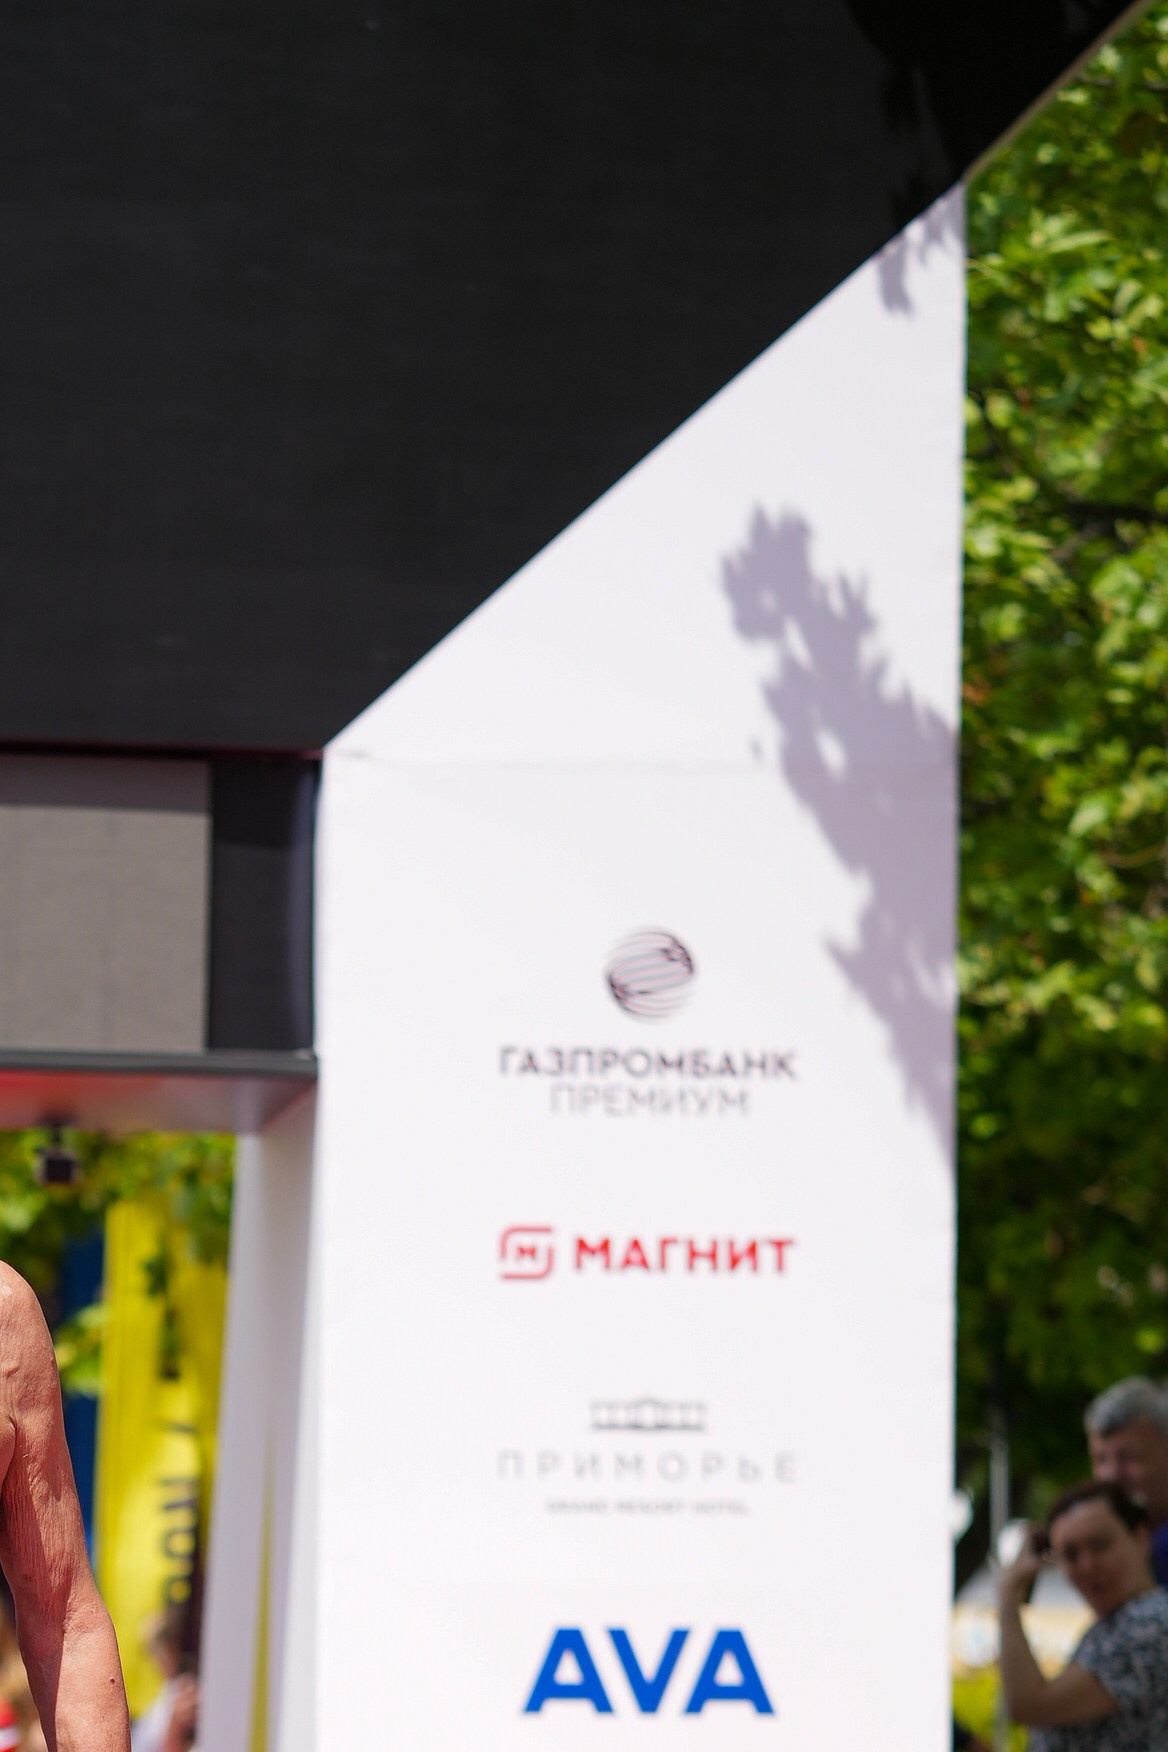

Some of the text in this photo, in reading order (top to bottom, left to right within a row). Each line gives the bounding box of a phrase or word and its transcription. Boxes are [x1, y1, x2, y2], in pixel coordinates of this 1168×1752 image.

[499, 1047, 798, 1080] ГАЗПРОМБАНК
[551, 1084, 748, 1117] ПРЕМИУМ
[575, 1237, 794, 1272] МАГНИТ
[497, 1450, 798, 1483] ПРИМОРЬЕ
[523, 1627, 774, 1714] AVA
